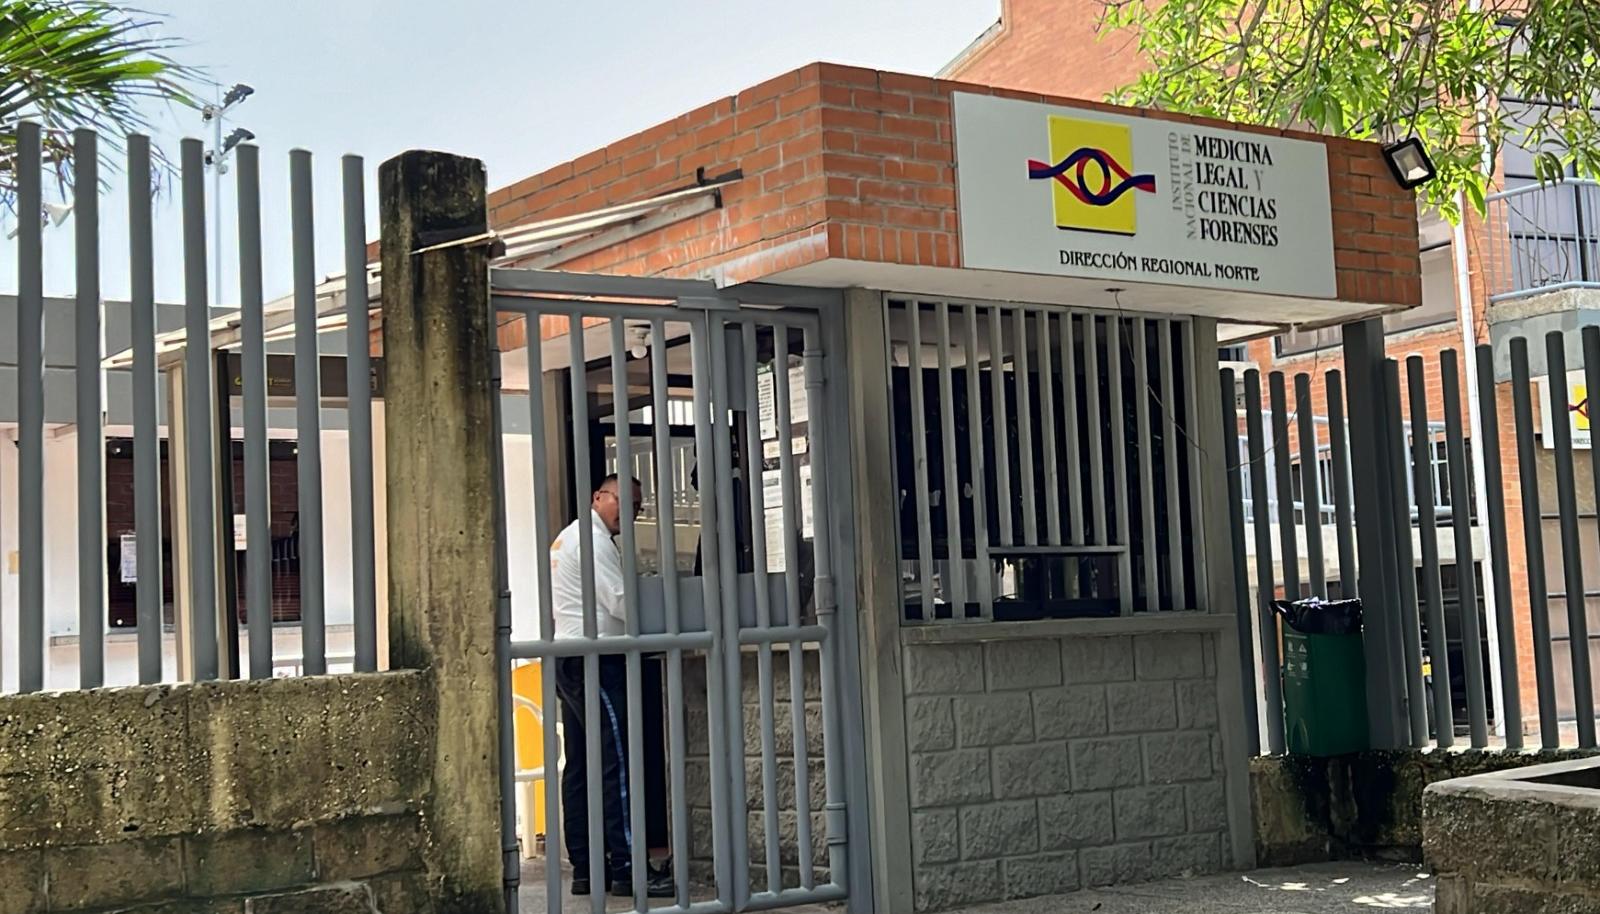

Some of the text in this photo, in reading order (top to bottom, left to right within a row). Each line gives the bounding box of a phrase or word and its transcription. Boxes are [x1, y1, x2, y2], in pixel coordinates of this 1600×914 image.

[1194, 134, 1274, 166] MEDICINA
[1168, 132, 1182, 211] INSTITUTO
[1181, 134, 1197, 240] NACIONAL DE
[1196, 162, 1264, 191] LEGAL Y
[1198, 191, 1277, 220] CIENCIAS
[1200, 218, 1279, 247] FORENSES
[1059, 250, 1260, 282] DIRECCIÓN REGIONAL NORTE
